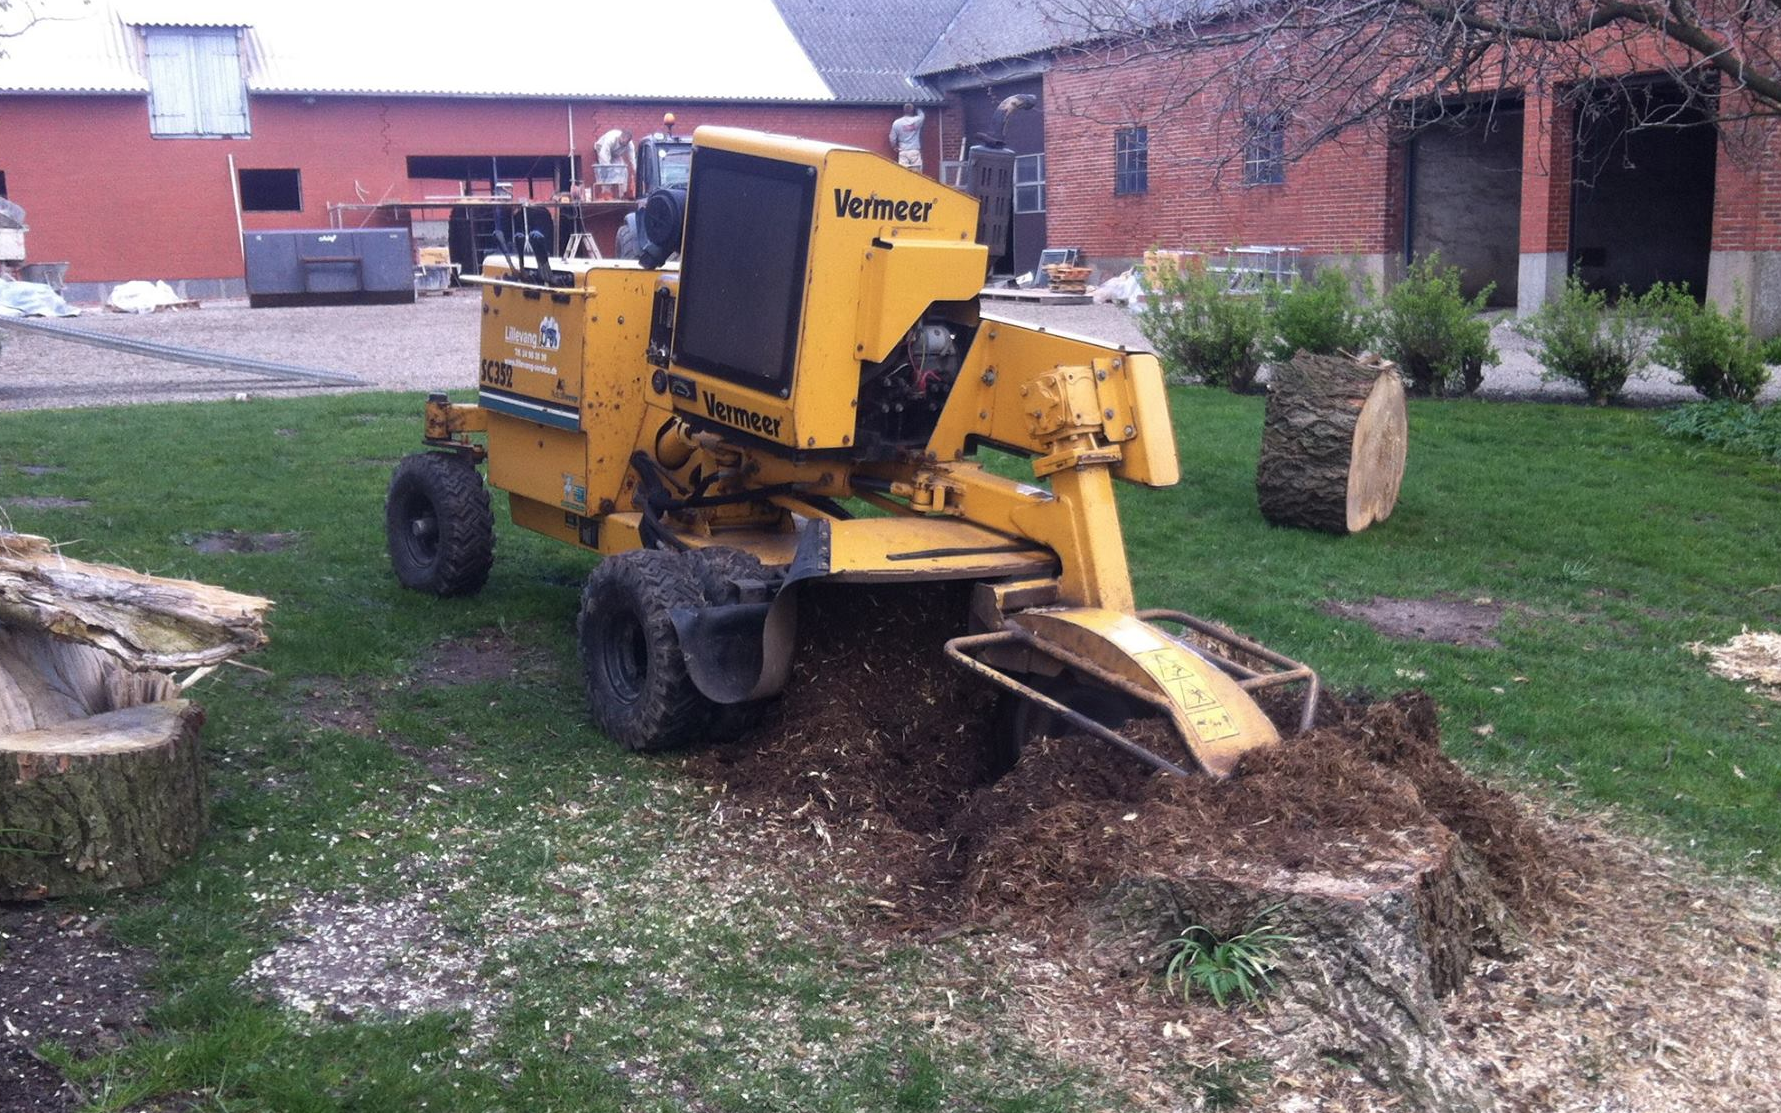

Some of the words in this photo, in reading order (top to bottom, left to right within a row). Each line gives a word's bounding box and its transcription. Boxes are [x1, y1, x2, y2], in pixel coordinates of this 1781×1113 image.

[834, 188, 933, 222] Vermeer
[505, 325, 537, 349] Lillevang
[481, 359, 513, 388] SC352
[702, 390, 781, 438] Vermeer
